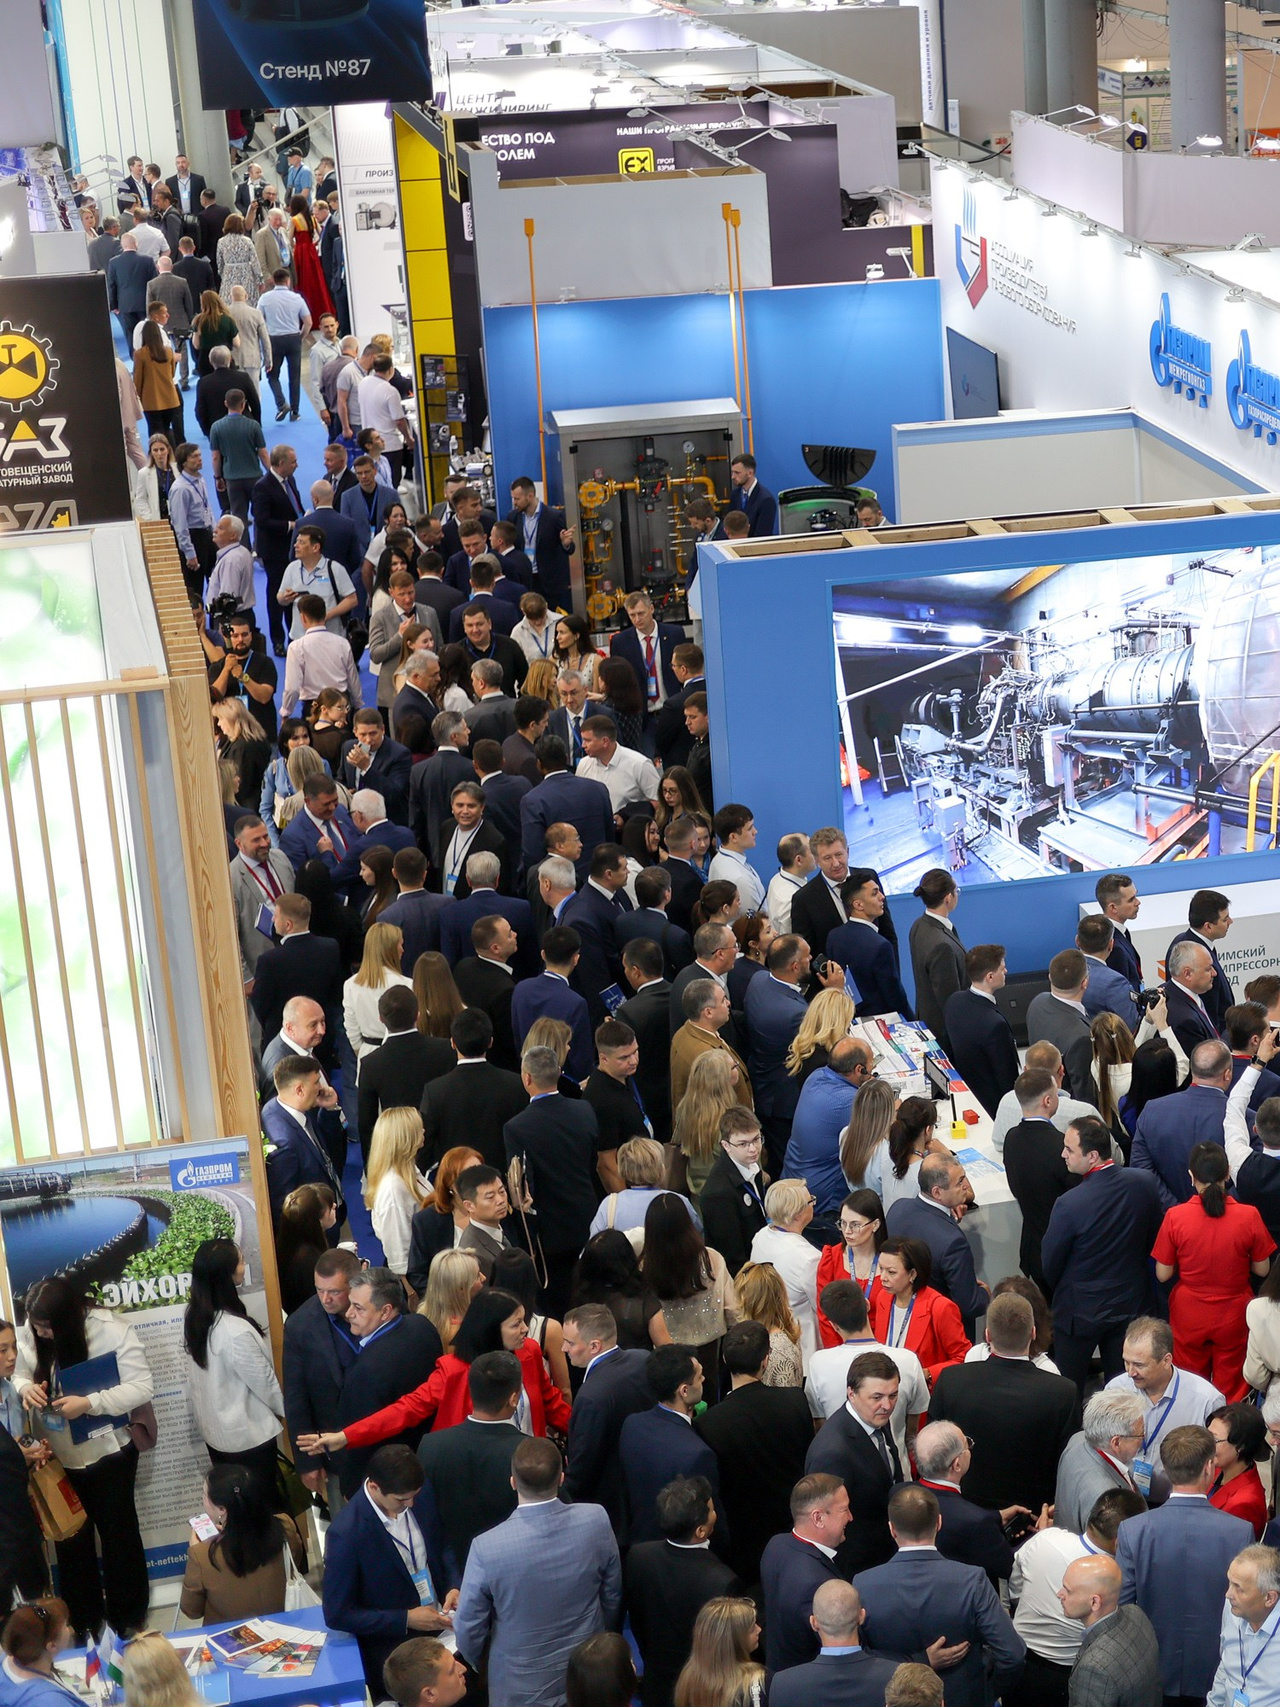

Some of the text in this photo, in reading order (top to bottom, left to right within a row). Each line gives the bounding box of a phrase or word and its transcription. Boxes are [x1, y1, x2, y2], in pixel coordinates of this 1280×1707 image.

[260, 58, 371, 81] Стенд №87
[617, 127, 643, 136] НАШИ
[525, 132, 556, 145] ПОД
[495, 148, 536, 161] ОЛЕМ
[365, 169, 394, 178] ПРОИЗ
[0, 461, 73, 478] ОВЕЩЕНСКИЙ
[42, 473, 74, 485] ЗАВОД
[195, 1162, 233, 1176] ГАЗПРОМ
[151, 1390, 183, 1400] рименение
